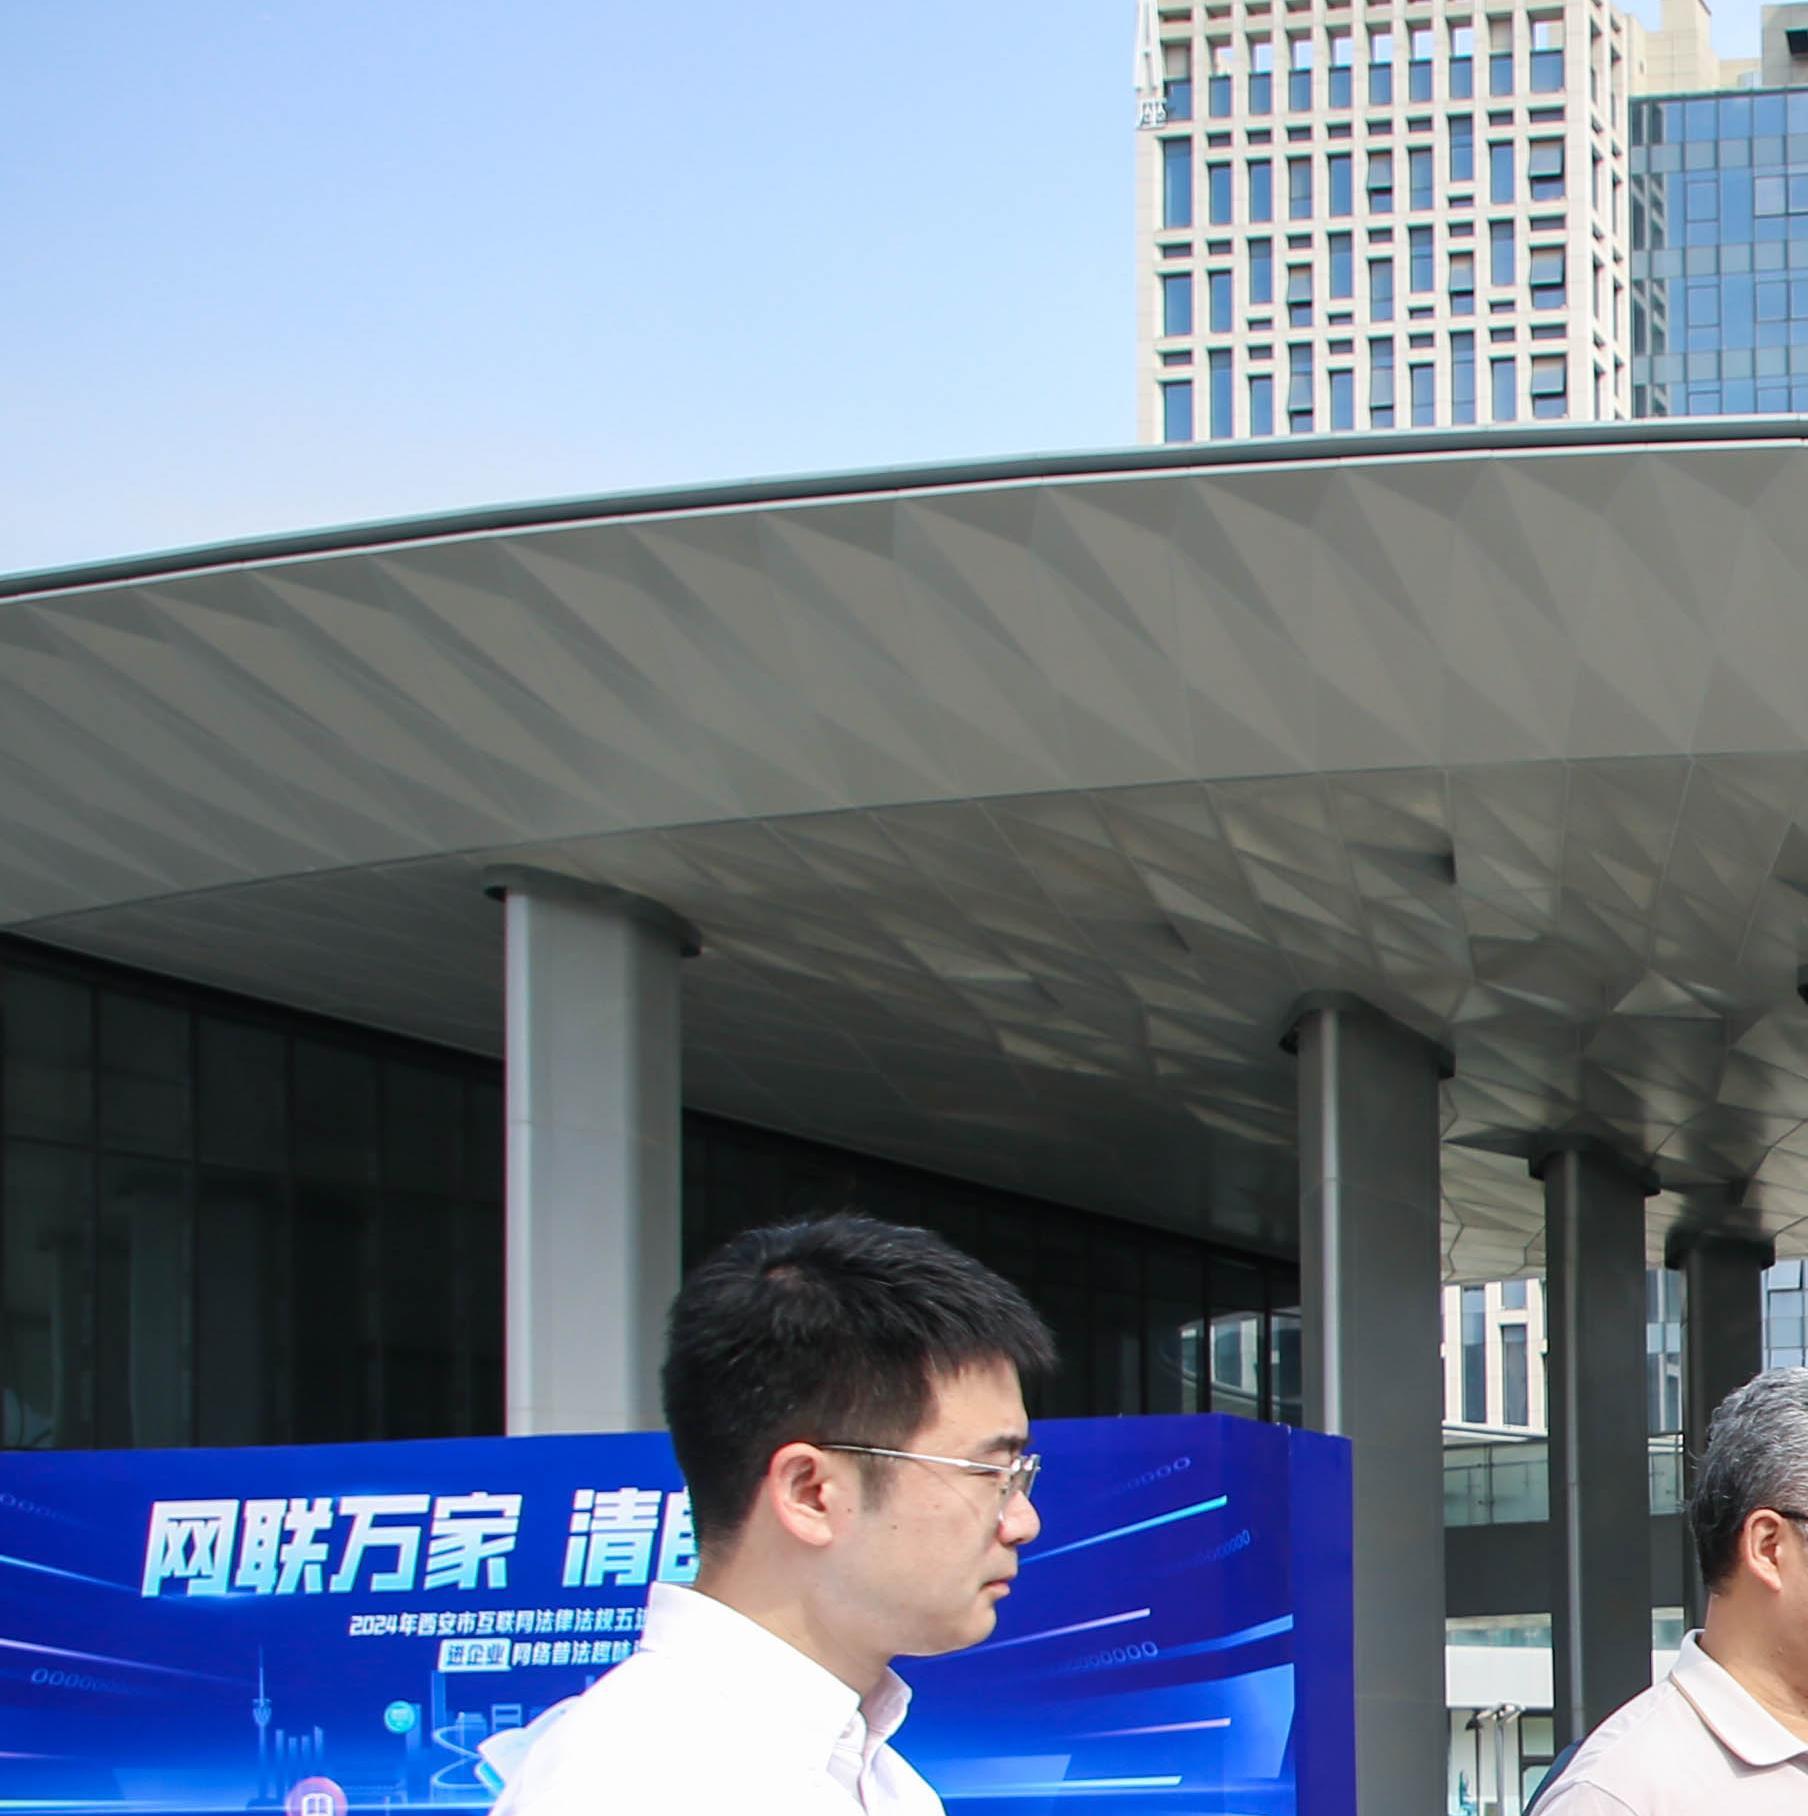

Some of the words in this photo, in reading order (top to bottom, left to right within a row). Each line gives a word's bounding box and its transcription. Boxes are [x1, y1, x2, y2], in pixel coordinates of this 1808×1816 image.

[142, 1490, 522, 1598] 网联万家
[511, 1639, 641, 1667] 网络普法趣味
